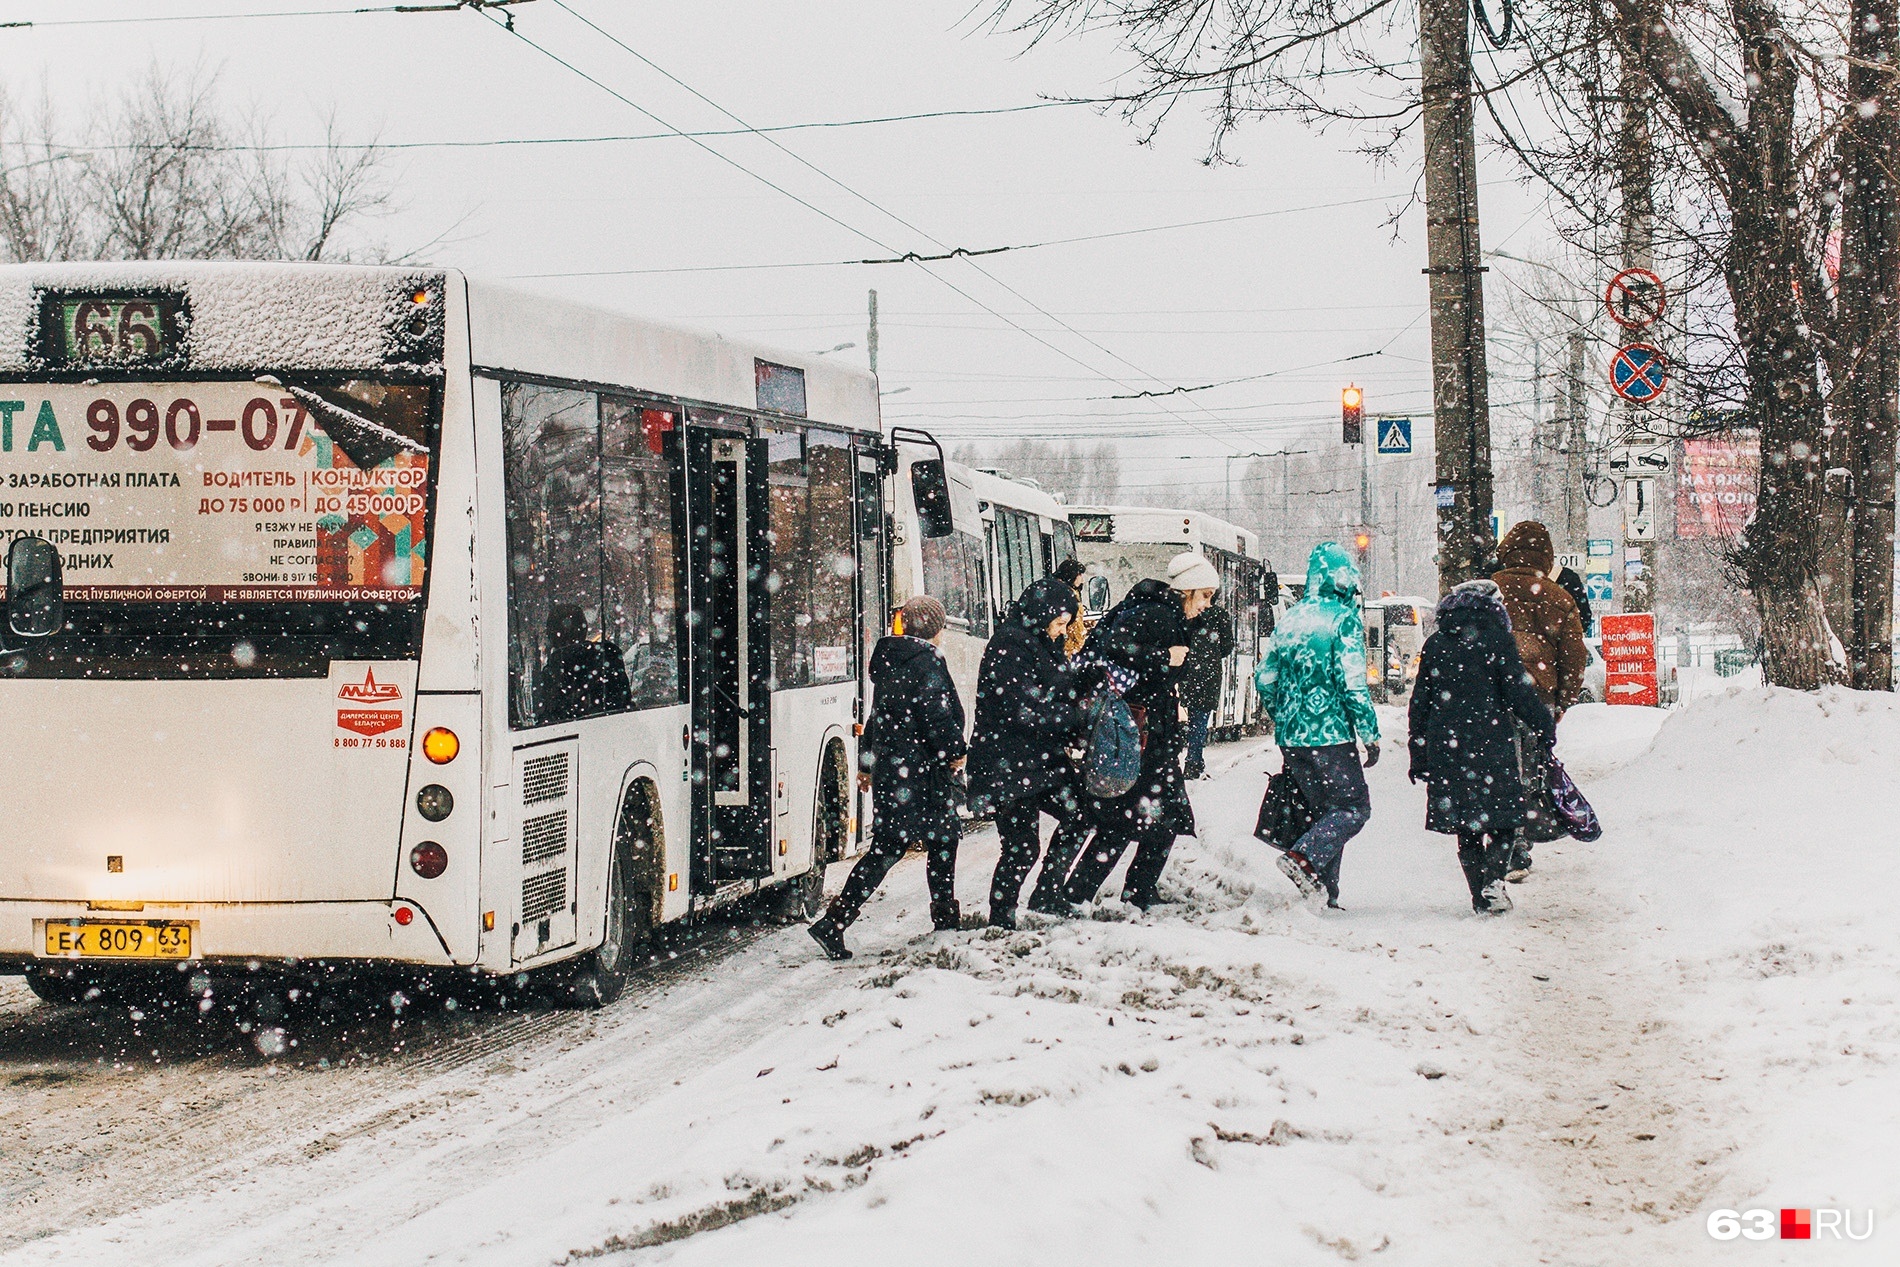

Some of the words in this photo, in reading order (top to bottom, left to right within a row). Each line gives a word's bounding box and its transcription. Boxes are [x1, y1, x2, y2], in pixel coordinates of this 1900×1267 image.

[75, 299, 160, 357] 66
[9, 473, 121, 488] ЗАРАБОТНАЯ
[126, 472, 181, 488] ПЛАТА
[203, 471, 296, 488] ВОДИТЕЛЬ
[311, 470, 425, 488] КОНДУКТОР
[18, 502, 91, 518] ПЕНСИЮ
[198, 498, 224, 515] ДО
[229, 498, 248, 513] 75
[253, 498, 285, 513] 000
[314, 498, 341, 514] ДО
[346, 498, 367, 513] 45
[368, 498, 409, 513] 000
[255, 523, 263, 532] Я
[265, 523, 296, 532] ЕЗЖУ
[298, 523, 313, 532] НЕ
[1079, 518, 1106, 535] 22
[49, 529, 170, 545] ПРЕДПРИЯТИЯ
[270, 555, 283, 565] НЕ
[242, 573, 281, 582] ЗВОНИ:
[282, 573, 289, 582] 8
[291, 573, 306, 582] 917
[62, 588, 88, 600] ЕТСЯ
[90, 586, 151, 600] ПУБЛИЧНОЙ
[154, 586, 207, 600] ОФЕРТОЙ
[223, 590, 237, 600] НЕ
[239, 590, 293, 600] ЯВЛЯЕТСЯ
[295, 587, 358, 600] ПУБЛИЧНОЙ
[361, 587, 415, 600] ОФЕРТОЙ
[1602, 632, 1652, 642] РАСПРОДАЖА
[1609, 646, 1647, 657] ЗИМНИХ
[1618, 662, 1642, 673] ШИН
[340, 666, 400, 697] МАЗ
[340, 711, 378, 720] ДИЛЕРСКИЙ
[380, 713, 400, 721] ЦЕНТР
[334, 738, 340, 748] 8
[342, 738, 358, 748] 800
[362, 738, 373, 749] 77
[375, 738, 387, 749] 50
[389, 738, 406, 749] 888
[99, 928, 143, 952] 809
[158, 928, 181, 946] 63
